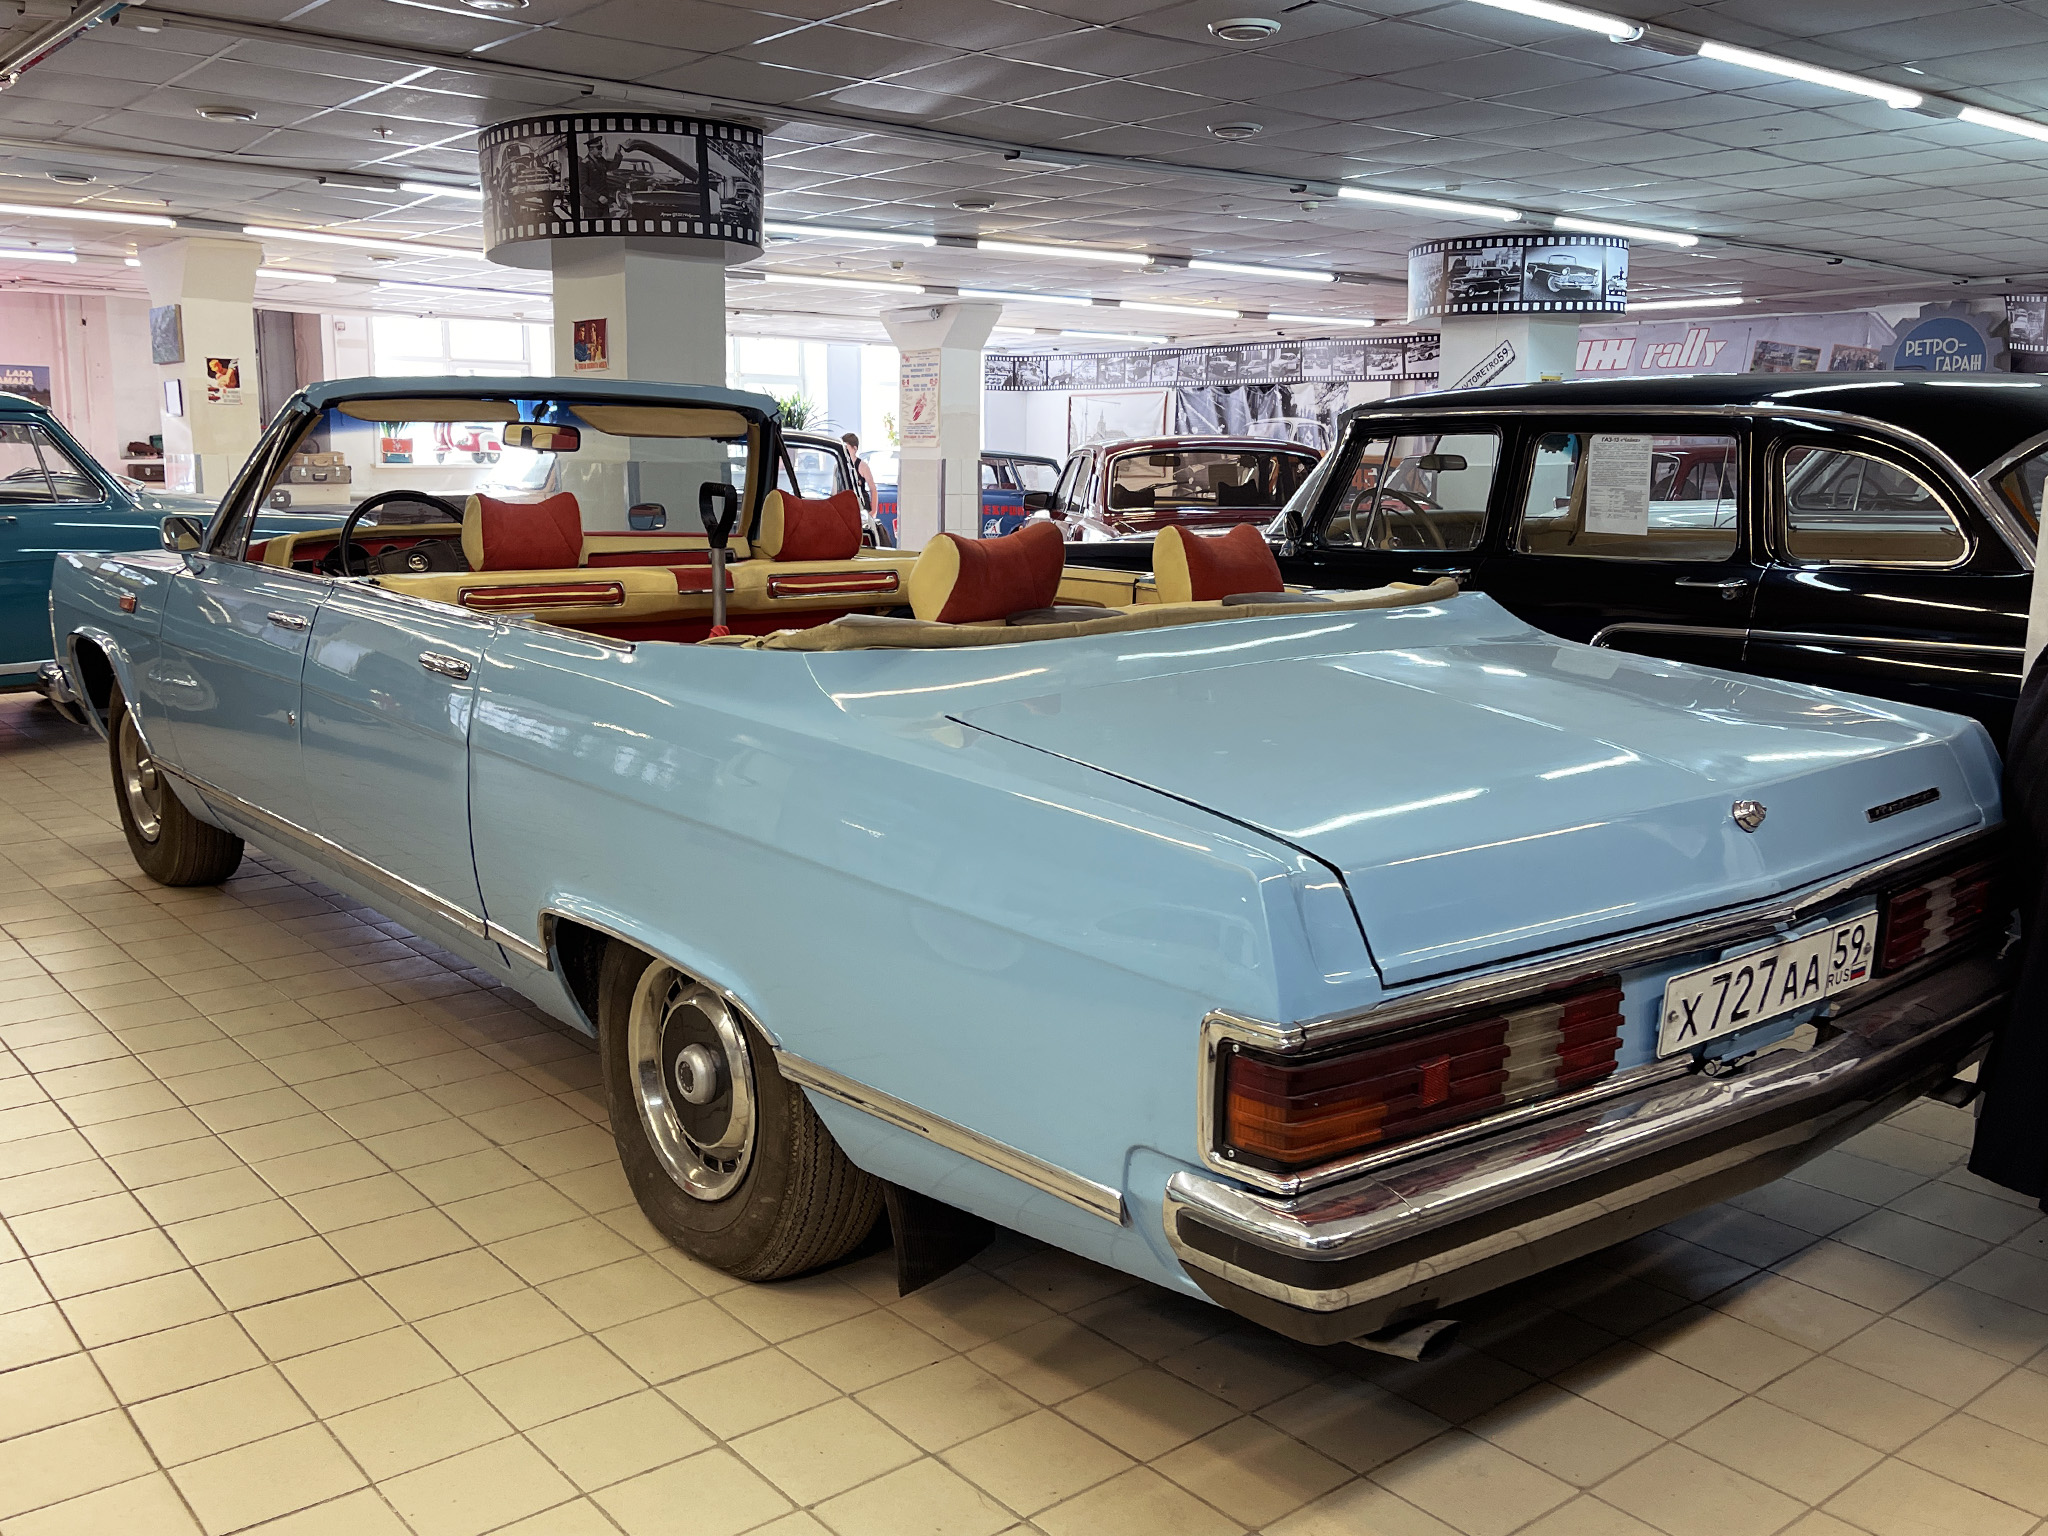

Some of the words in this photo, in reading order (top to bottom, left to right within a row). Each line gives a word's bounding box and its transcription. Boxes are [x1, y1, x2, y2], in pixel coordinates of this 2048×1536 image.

[1640, 328, 1728, 370] rally
[1905, 337, 1967, 357] РЕТРО-
[1935, 354, 1982, 372] ГАРАЖ
[6, 369, 33, 378] LADA
[1832, 924, 1866, 970] 59
[1826, 969, 1851, 990] RUS
